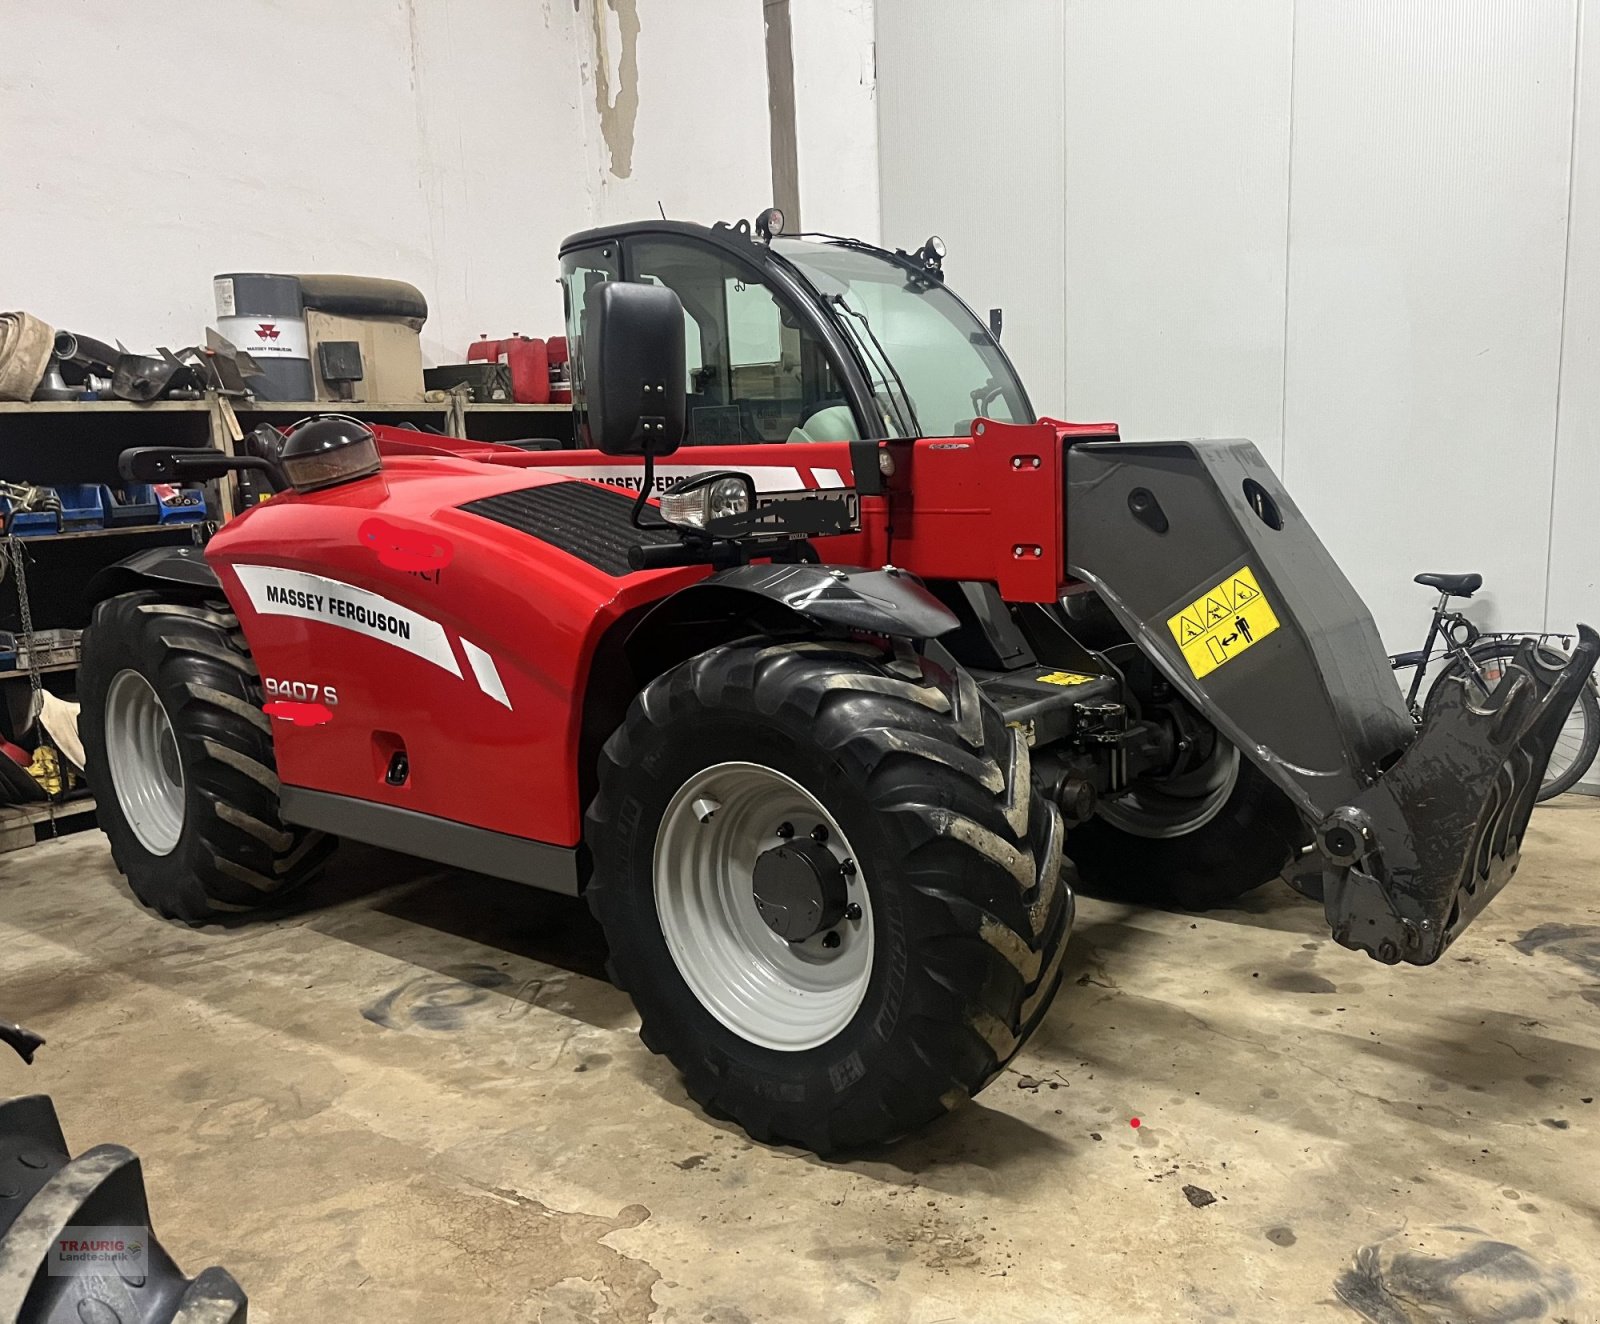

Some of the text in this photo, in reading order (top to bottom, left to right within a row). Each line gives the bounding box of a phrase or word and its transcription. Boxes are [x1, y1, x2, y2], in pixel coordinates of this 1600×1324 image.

[266, 585, 411, 640] MASSEY FERGUSON
[265, 677, 339, 705] 9407 S
